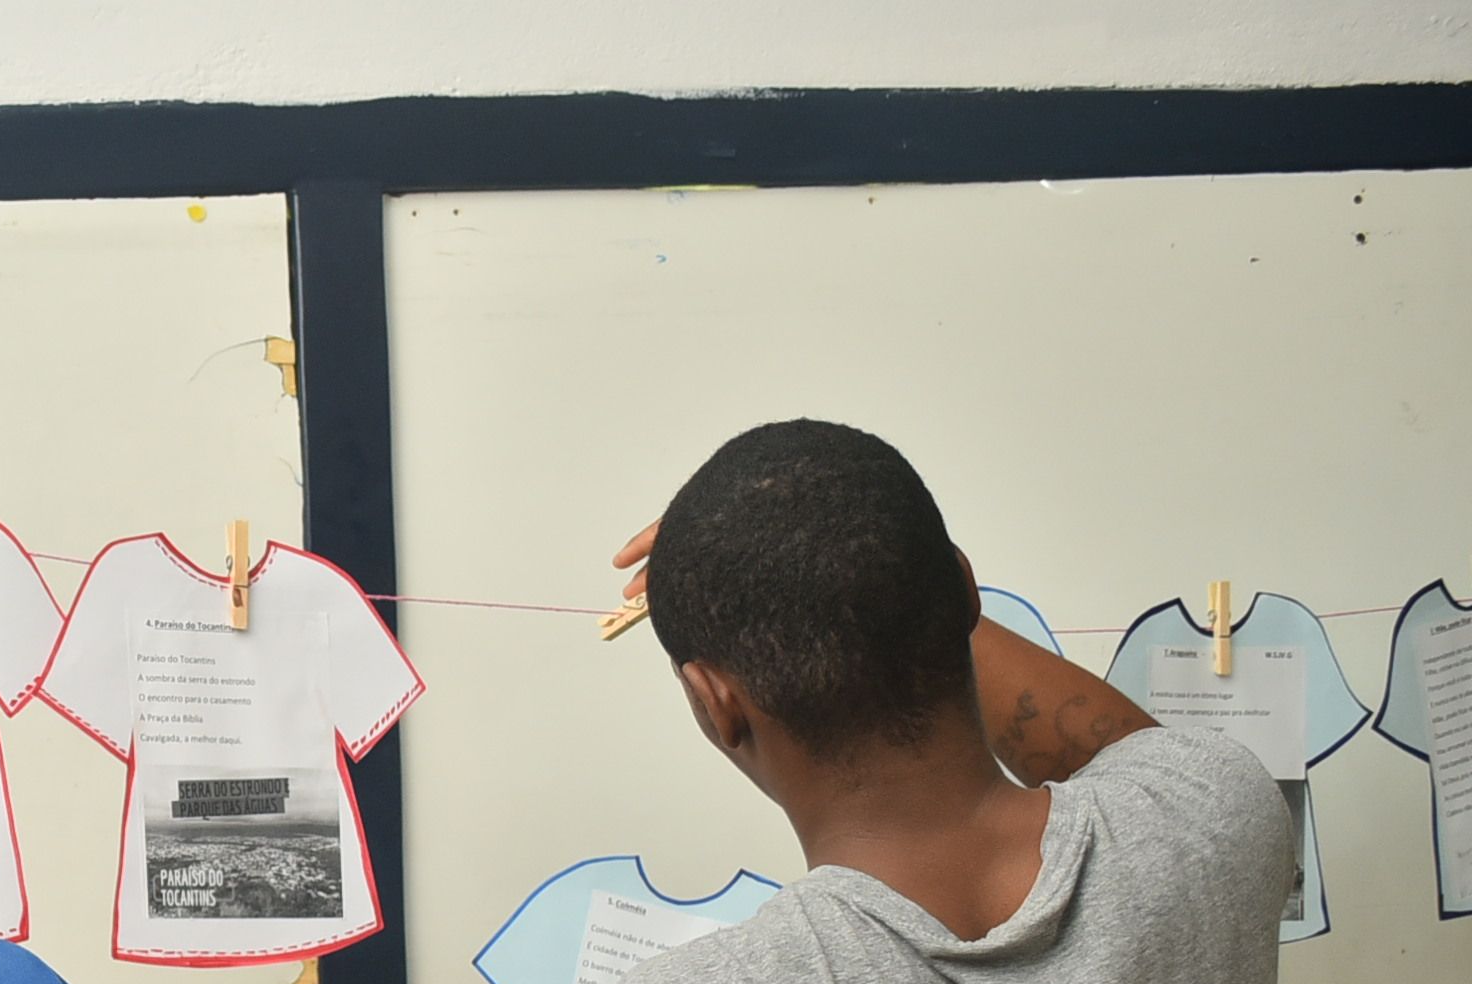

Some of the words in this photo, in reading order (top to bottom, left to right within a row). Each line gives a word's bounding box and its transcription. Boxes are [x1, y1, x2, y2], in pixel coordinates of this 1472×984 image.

[186, 621, 196, 630] do
[197, 622, 234, 632] Tocantin
[168, 654, 178, 663] do
[180, 655, 216, 665] Tocantins
[146, 674, 175, 683] sombra
[177, 675, 187, 683] da
[209, 676, 219, 685] do
[221, 677, 256, 686] estrondo
[139, 694, 146, 702] O
[147, 695, 183, 703] encontro
[185, 696, 201, 704] para
[210, 697, 252, 705] casamento
[147, 714, 169, 724] Praça
[171, 714, 181, 722] da
[140, 733, 182, 744] Cavalgada,
[191, 735, 218, 743] melhor
[179, 782, 210, 799] SERRA
[215, 781, 228, 797] DO
[230, 779, 282, 796] ESTRONDO
[180, 801, 220, 819] PARQUE
[222, 800, 242, 815] DAS
[160, 867, 206, 887] PARAÍSO
[208, 869, 224, 886] DO
[160, 889, 216, 906] TOCANTINS
[623, 931, 637, 943] não
[645, 938, 655, 947] de
[593, 944, 618, 957] cidade
[582, 959, 589, 968] O
